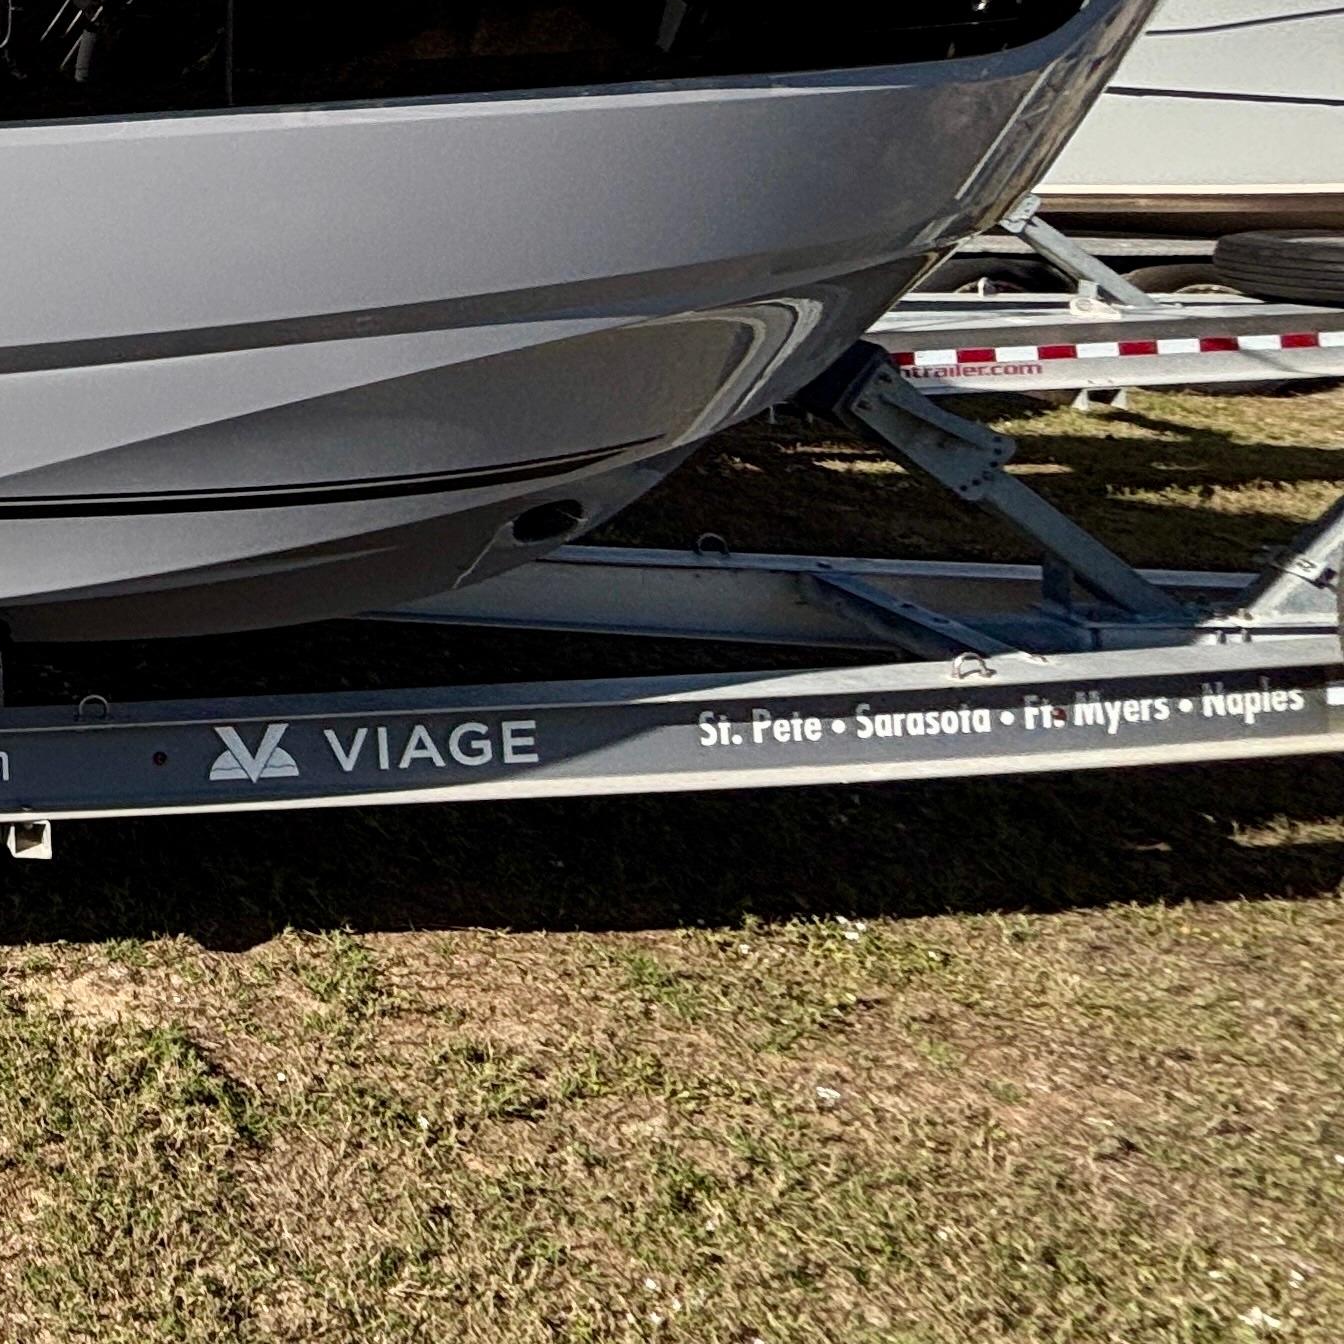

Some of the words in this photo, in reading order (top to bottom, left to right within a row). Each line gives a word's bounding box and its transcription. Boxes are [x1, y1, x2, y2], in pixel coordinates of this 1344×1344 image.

[900, 362, 1043, 378] ntrailer.com
[698, 707, 743, 746] St.
[752, 707, 823, 743] Pete
[855, 703, 991, 738] Sarasota
[1073, 690, 1171, 735] Myers
[1201, 675, 1305, 725] Naples
[323, 719, 539, 772] VIAGE
